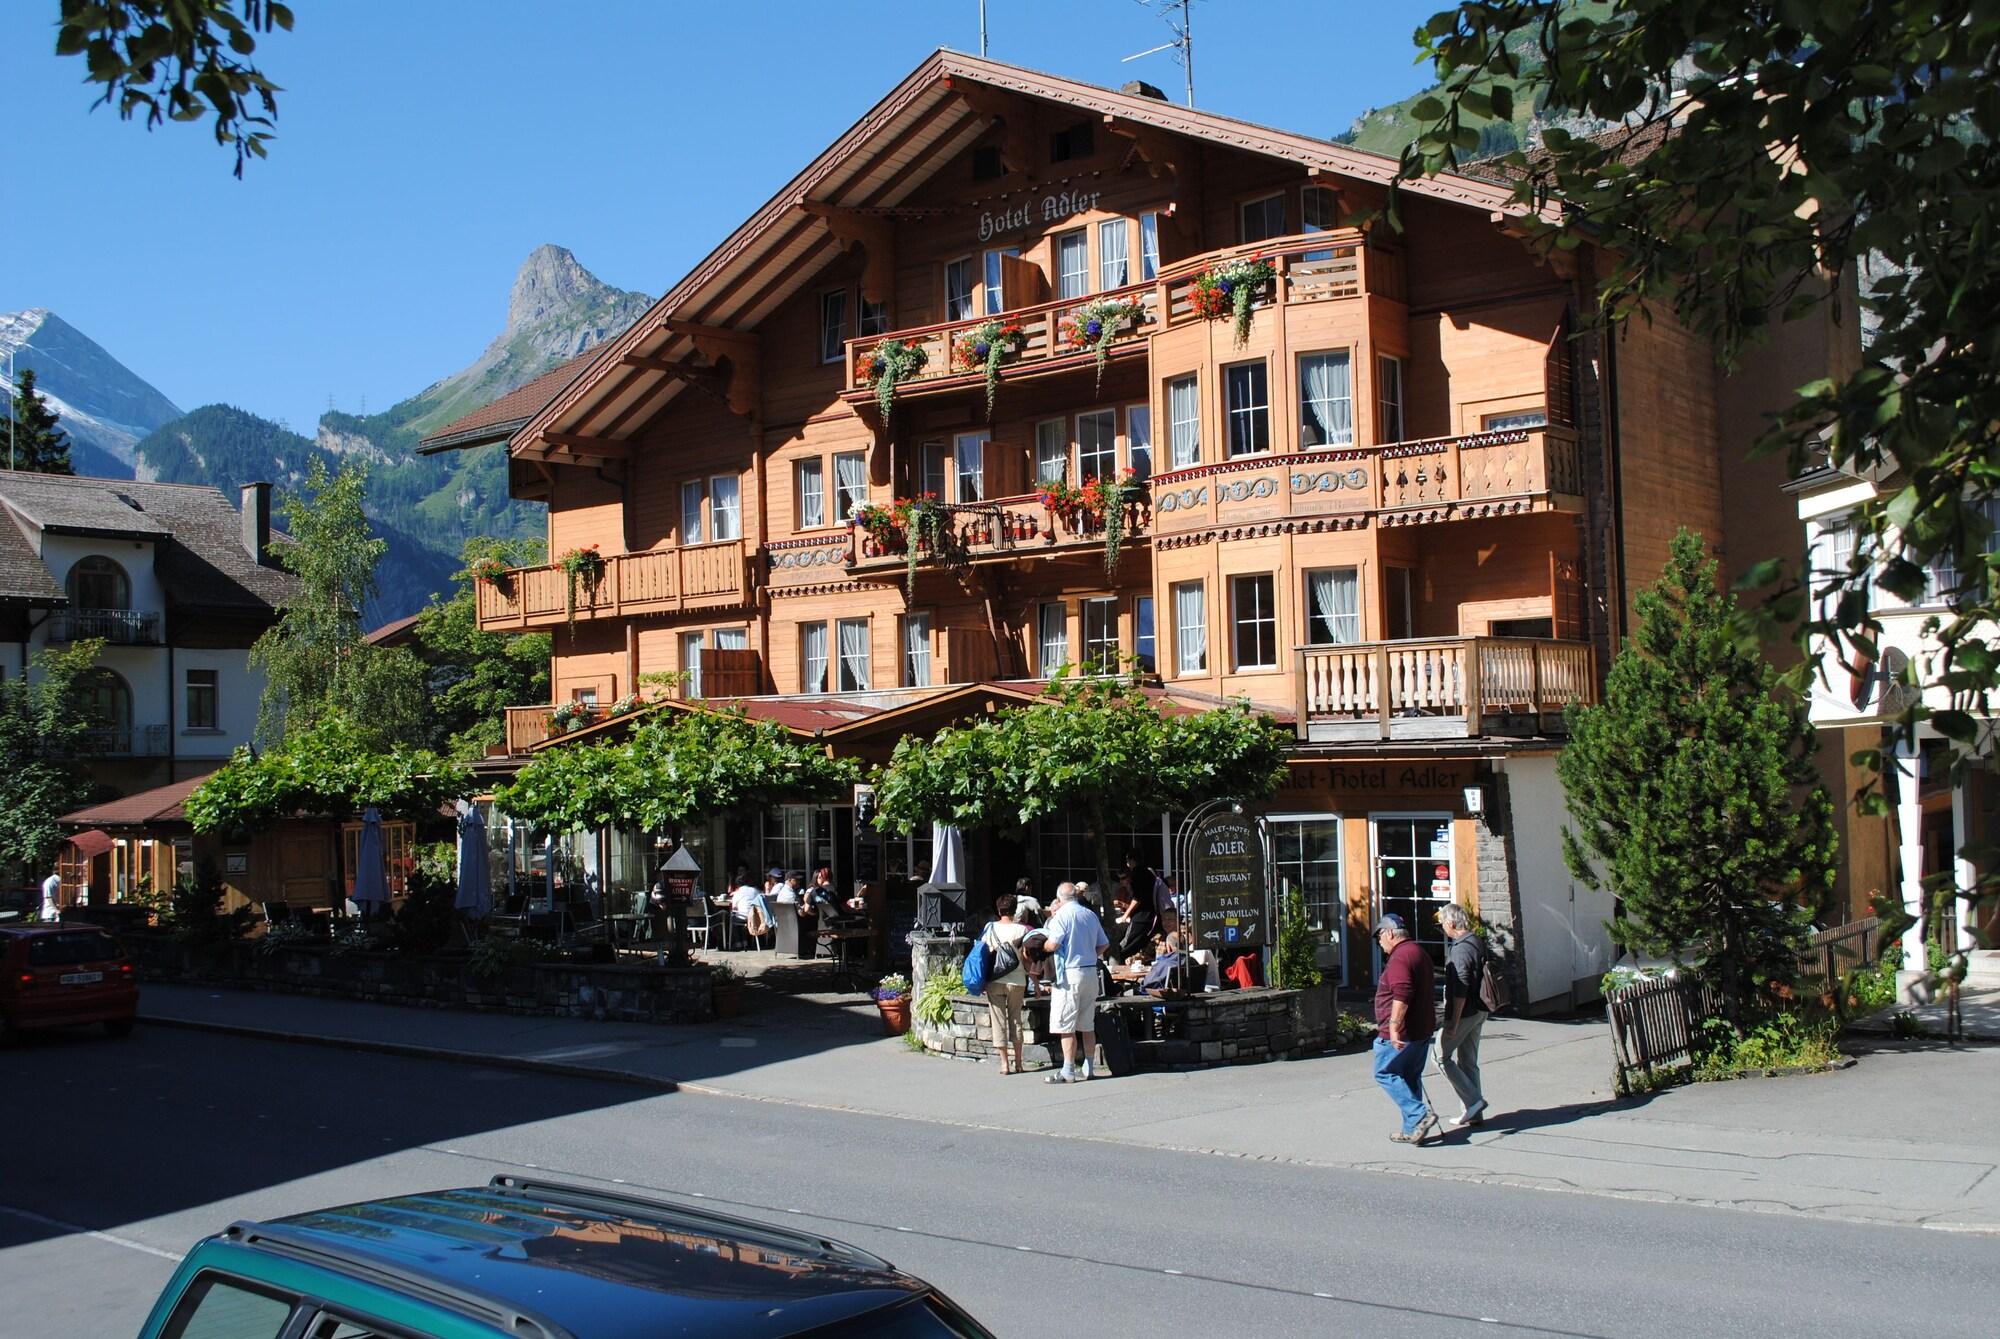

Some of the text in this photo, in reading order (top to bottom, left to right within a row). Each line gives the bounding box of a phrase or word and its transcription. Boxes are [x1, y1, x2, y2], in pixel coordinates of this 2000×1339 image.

[978, 188, 1101, 242] Hotel Adler
[1279, 766, 1460, 790] alet-Hotel Adler
[1209, 841, 1245, 855] ADLER
[1206, 872, 1251, 884] RESTAURANT
[1201, 909, 1259, 921] SNACK PAVILLON
[1228, 927, 1236, 942] P
